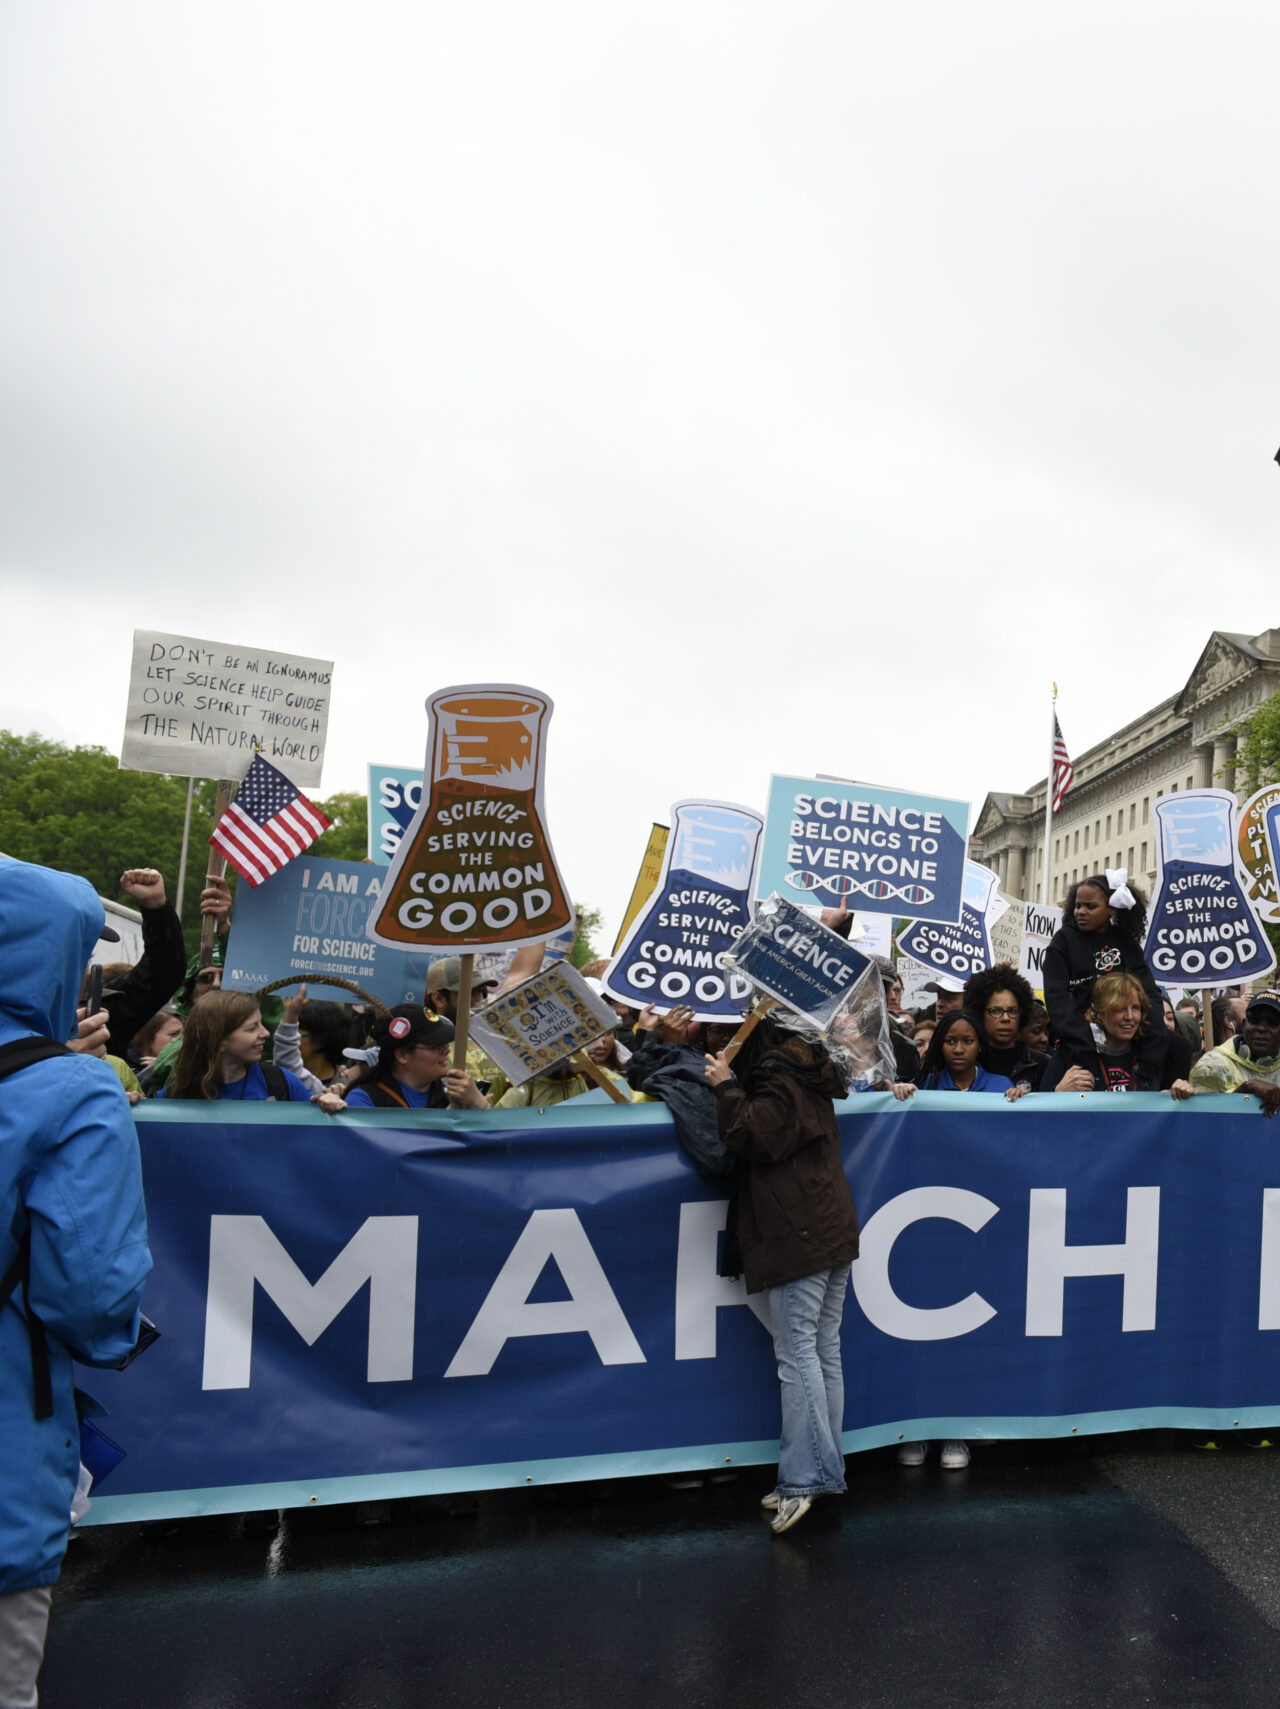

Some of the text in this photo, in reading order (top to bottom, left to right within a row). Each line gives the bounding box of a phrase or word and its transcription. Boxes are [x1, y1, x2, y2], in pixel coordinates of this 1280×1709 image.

[150, 643, 331, 685] DON'T BE AN IGNORAMUS
[147, 666, 325, 712] LET SCIENCE HELP GUIDE
[143, 687, 319, 732] OUR SPIRIT THROUGH
[140, 714, 319, 762] THE NATURAL WORLD
[437, 800, 527, 826] SCIENCE
[793, 794, 943, 834] SCIENCE
[427, 831, 534, 852] SERVING
[789, 820, 939, 855] BELONGS TO
[459, 852, 493, 866] THE
[786, 844, 938, 881] EVERYONE
[302, 869, 383, 897] I AM A
[409, 862, 545, 894] COMMON
[1169, 874, 1231, 895] SCIENCE
[398, 888, 552, 933] GOOD
[669, 890, 740, 916] SCIENCE
[1165, 896, 1239, 915] SERVING
[658, 913, 744, 939] SERVING
[945, 926, 961, 938] THE
[1157, 919, 1250, 945] COMMON
[1187, 913, 1212, 924] THE
[292, 935, 377, 961] FOR SCIENCE
[682, 931, 710, 946] THE
[760, 915, 854, 987] SCIENCE
[920, 926, 984, 958] COMMON
[640, 941, 728, 970] COMMO
[767, 950, 795, 972] AMERICA
[794, 968, 816, 985] GREAT
[912, 937, 986, 974] GOOD
[1152, 938, 1258, 974] GOOD
[627, 961, 754, 1003] GOOD
[530, 1000, 557, 1019] I'm
[529, 1016, 575, 1046] SCIENCE
